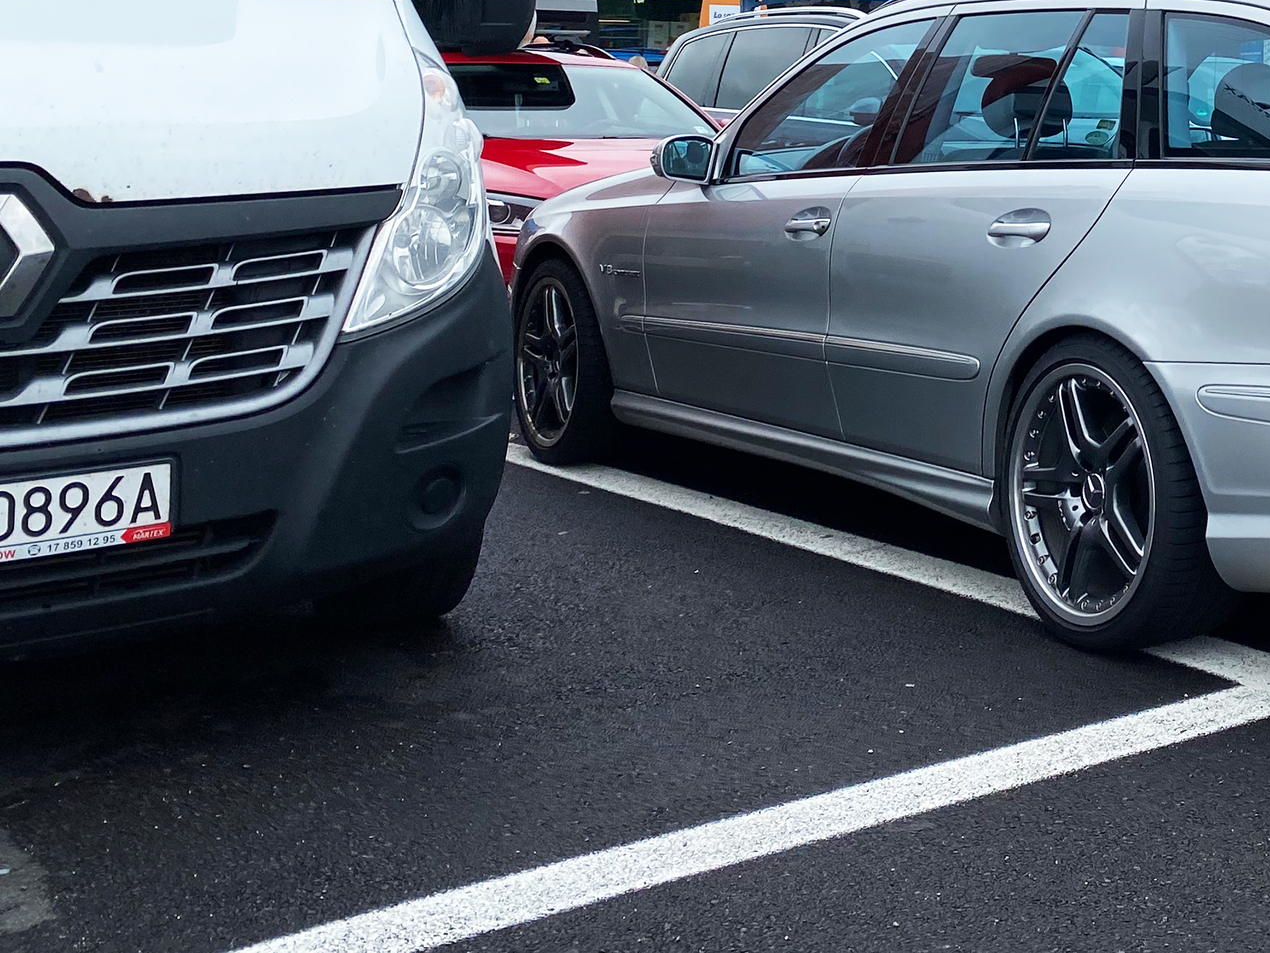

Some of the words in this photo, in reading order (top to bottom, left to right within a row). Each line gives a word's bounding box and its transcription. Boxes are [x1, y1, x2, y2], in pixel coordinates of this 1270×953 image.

[599, 263, 613, 274] V8
[47, 542, 60, 553] 17
[63, 539, 83, 550] 859
[87, 537, 100, 547] 12
[103, 534, 116, 544] 95
[132, 528, 165, 540] MARTEX
